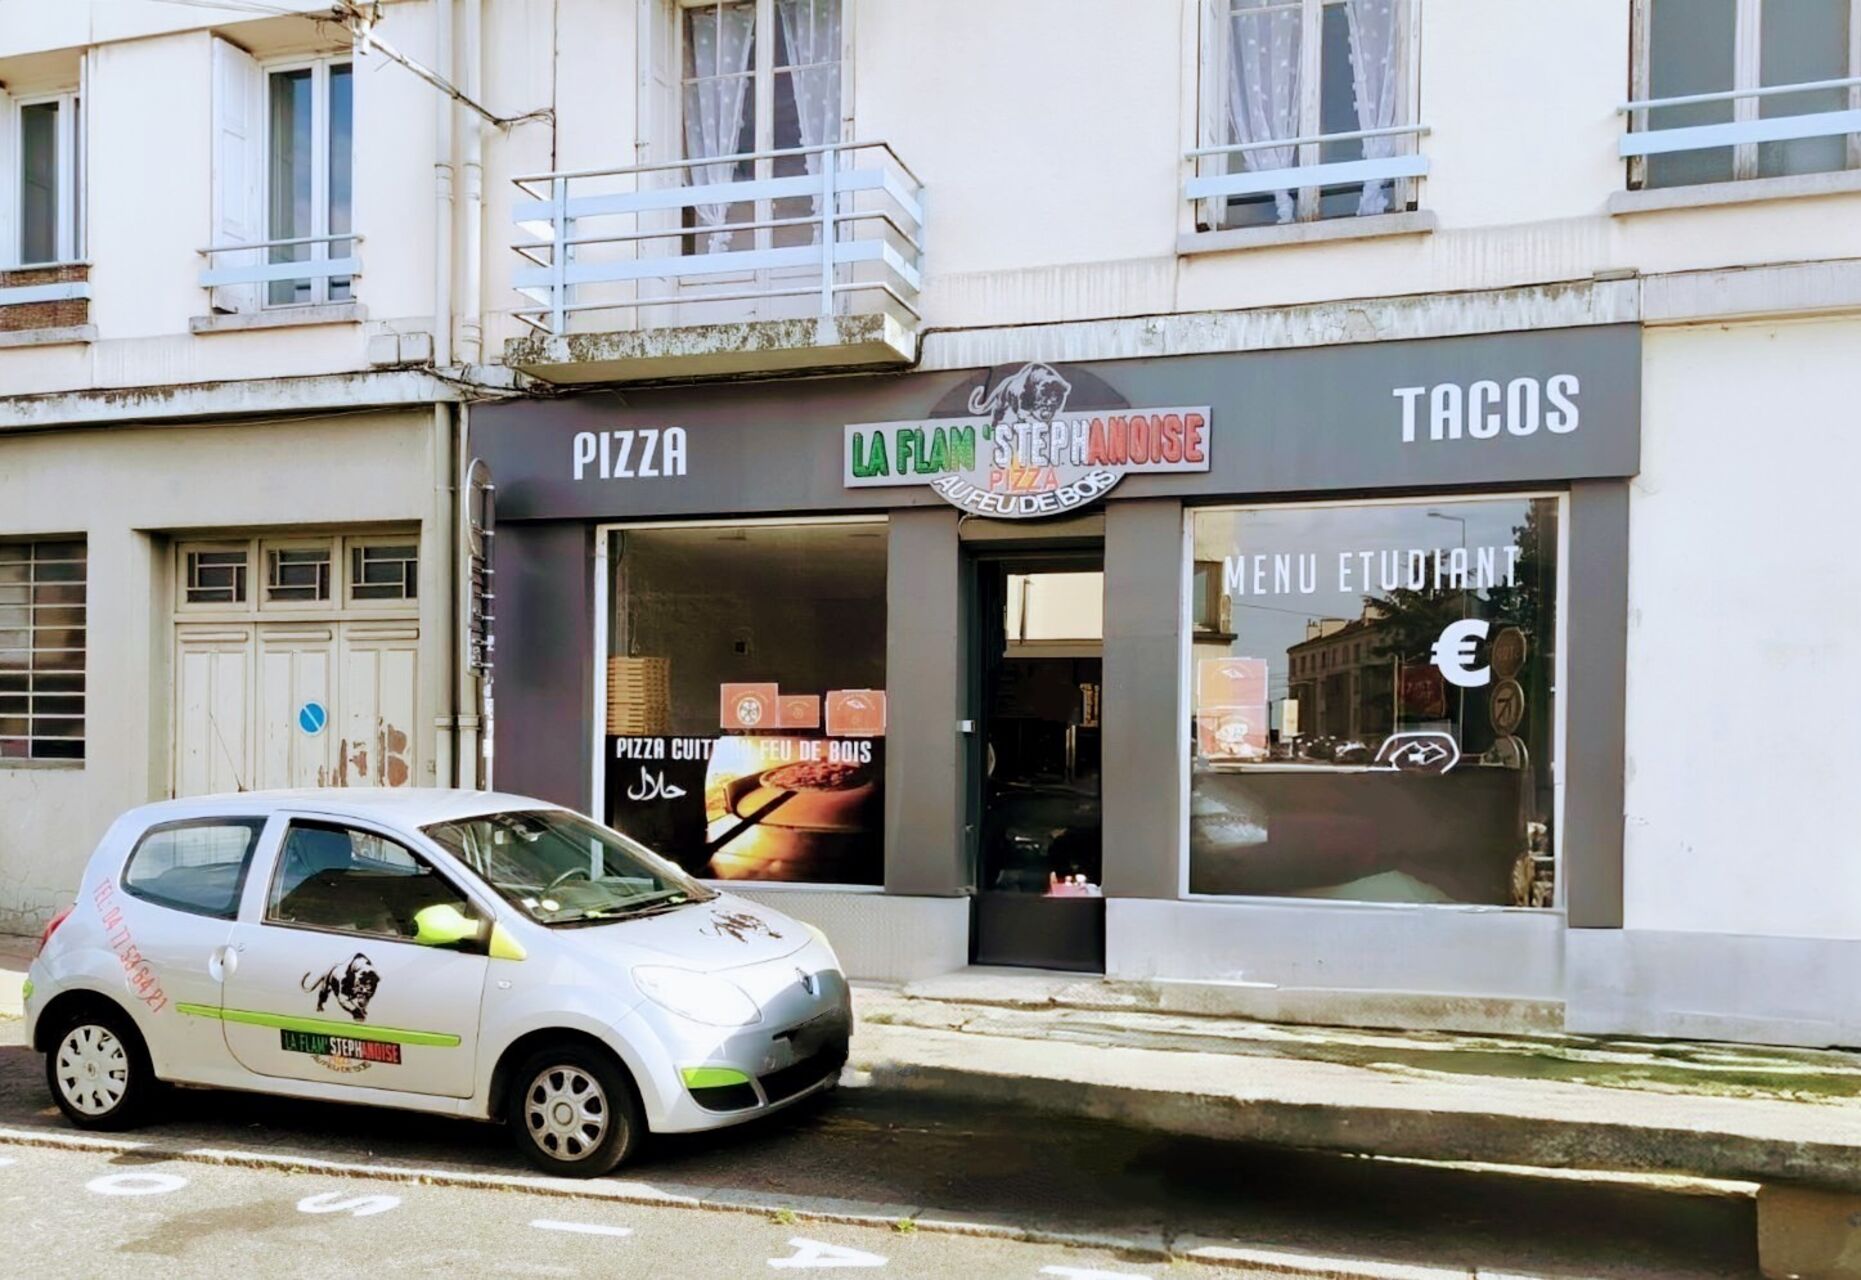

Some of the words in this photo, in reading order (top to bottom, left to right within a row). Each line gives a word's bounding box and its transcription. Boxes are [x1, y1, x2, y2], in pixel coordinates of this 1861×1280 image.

[1392, 374, 1580, 442] TACOS
[573, 426, 687, 480] PIZZA
[852, 429, 890, 478] LA
[933, 474, 967, 500] AU
[964, 488, 1018, 515] FEU
[1019, 491, 1060, 515] DE
[1056, 468, 1117, 508] BOIS
[989, 468, 1060, 493] PIZZA
[1223, 553, 1317, 596] MENU
[1338, 545, 1520, 593] ETUDIANT
[1429, 618, 1491, 688] €
[616, 737, 665, 759] PIZZA
[760, 739, 791, 761] FEU
[800, 739, 821, 762] DE
[829, 739, 873, 764] BOIS
[627, 765, 687, 801] حلال
[102, 906, 123, 932] 04
[284, 1031, 297, 1050] LA
